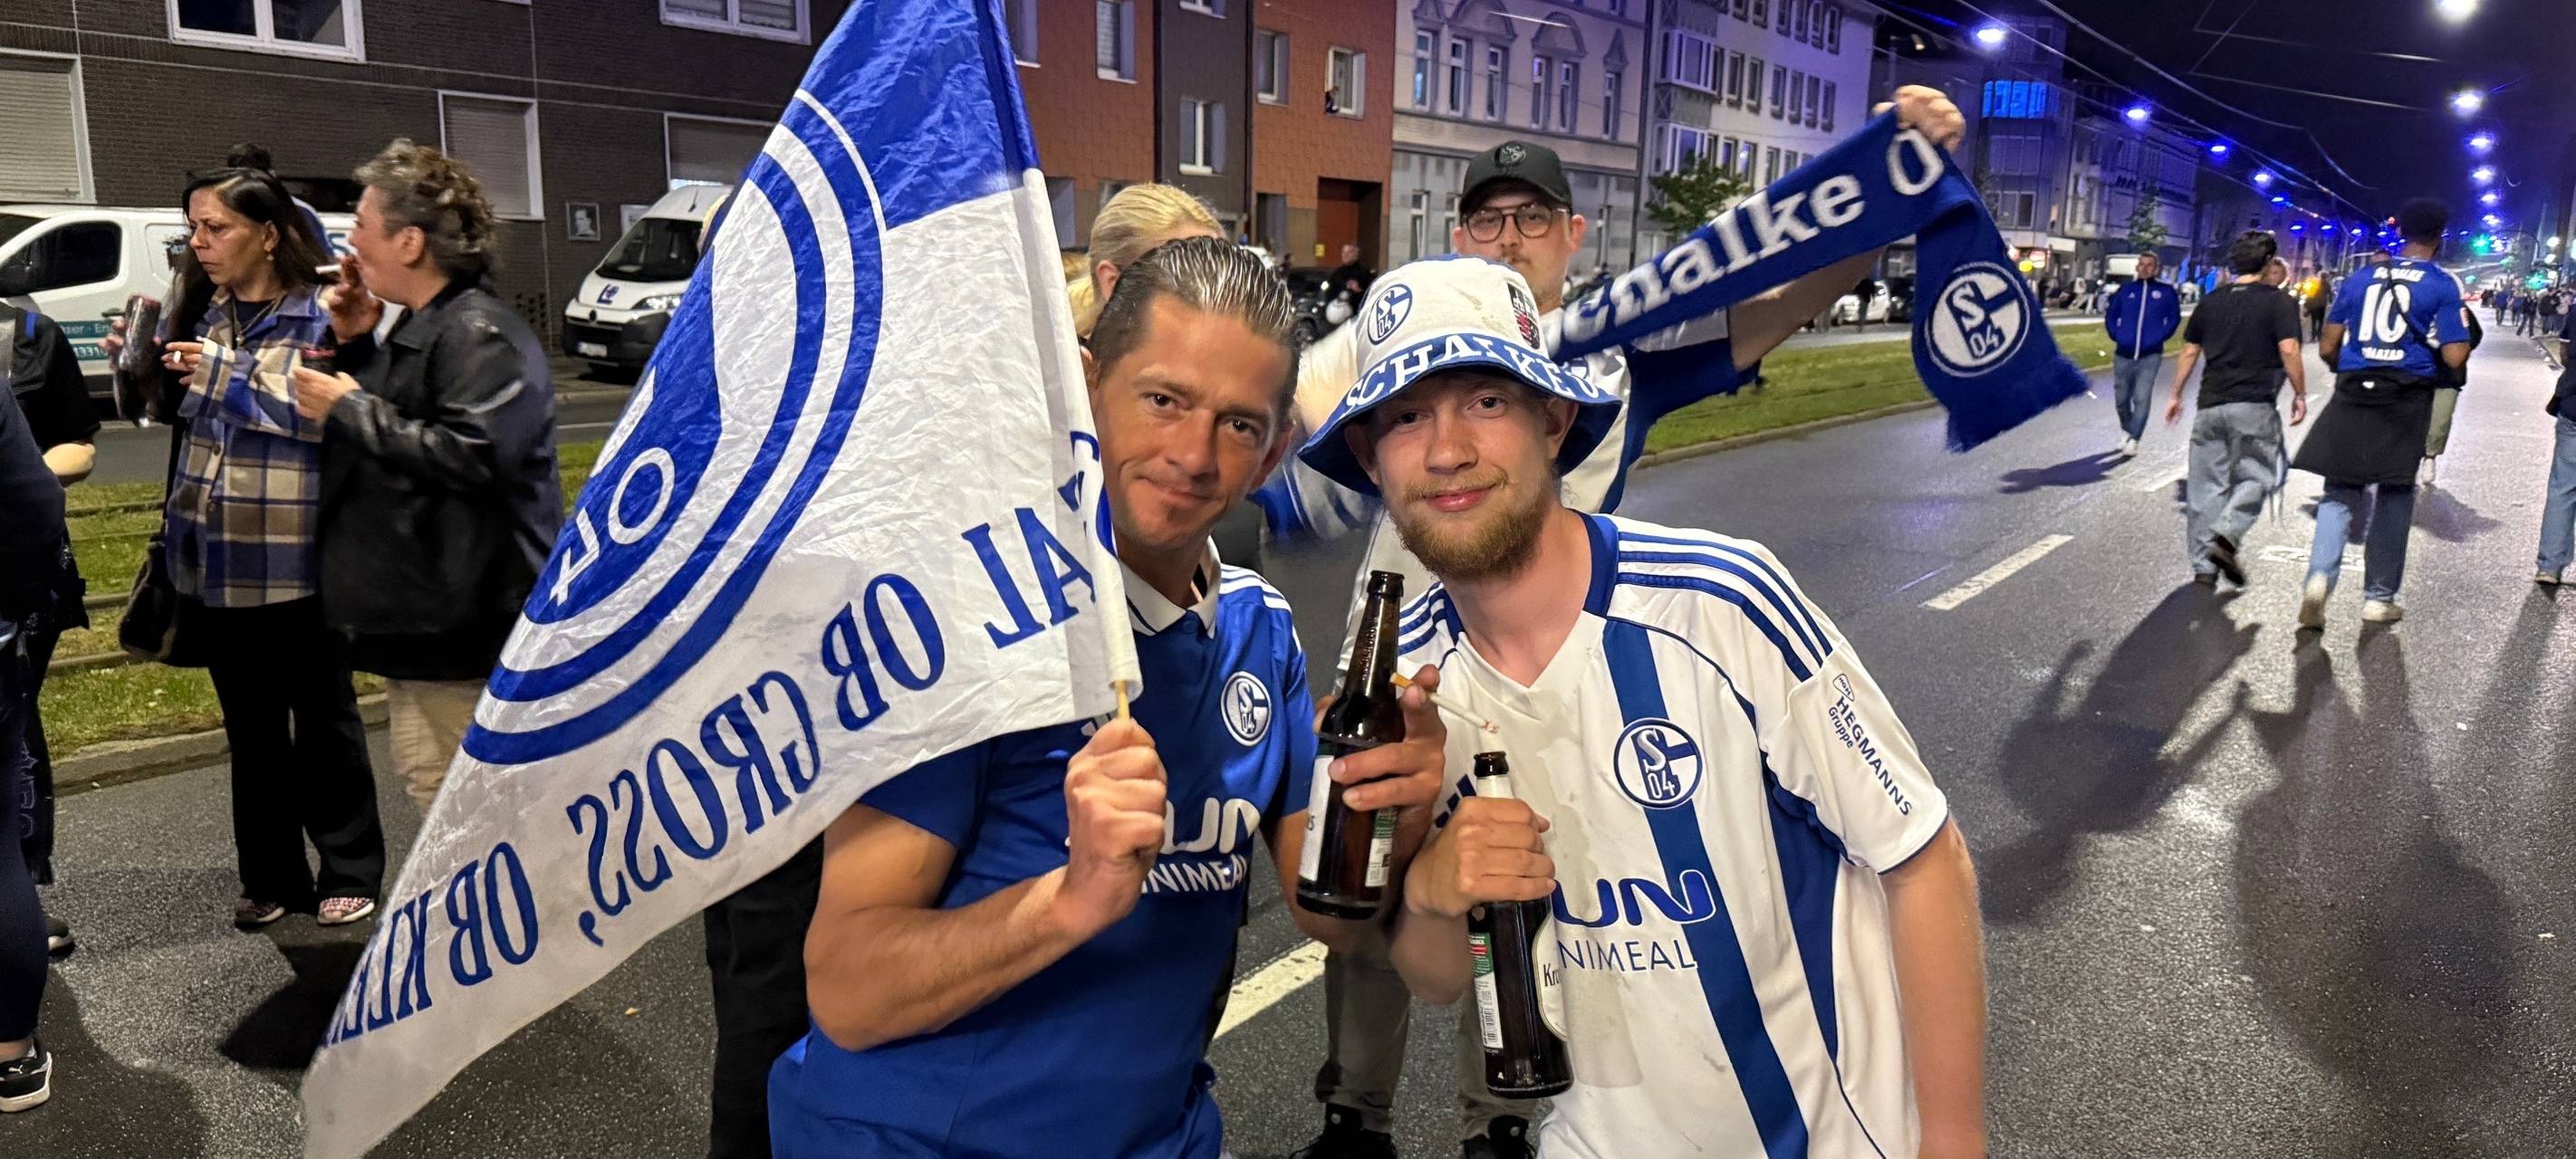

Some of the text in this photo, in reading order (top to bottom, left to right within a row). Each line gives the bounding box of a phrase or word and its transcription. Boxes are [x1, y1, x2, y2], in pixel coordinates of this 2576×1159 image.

[1547, 174, 1864, 354] chalke
[2358, 283, 2411, 343] 10
[1828, 706, 1854, 750] Gruppe
[1836, 695, 1913, 816] HEGMANNS
[1551, 869, 1716, 929] UN
[1557, 939, 1698, 972] NIMEAL
